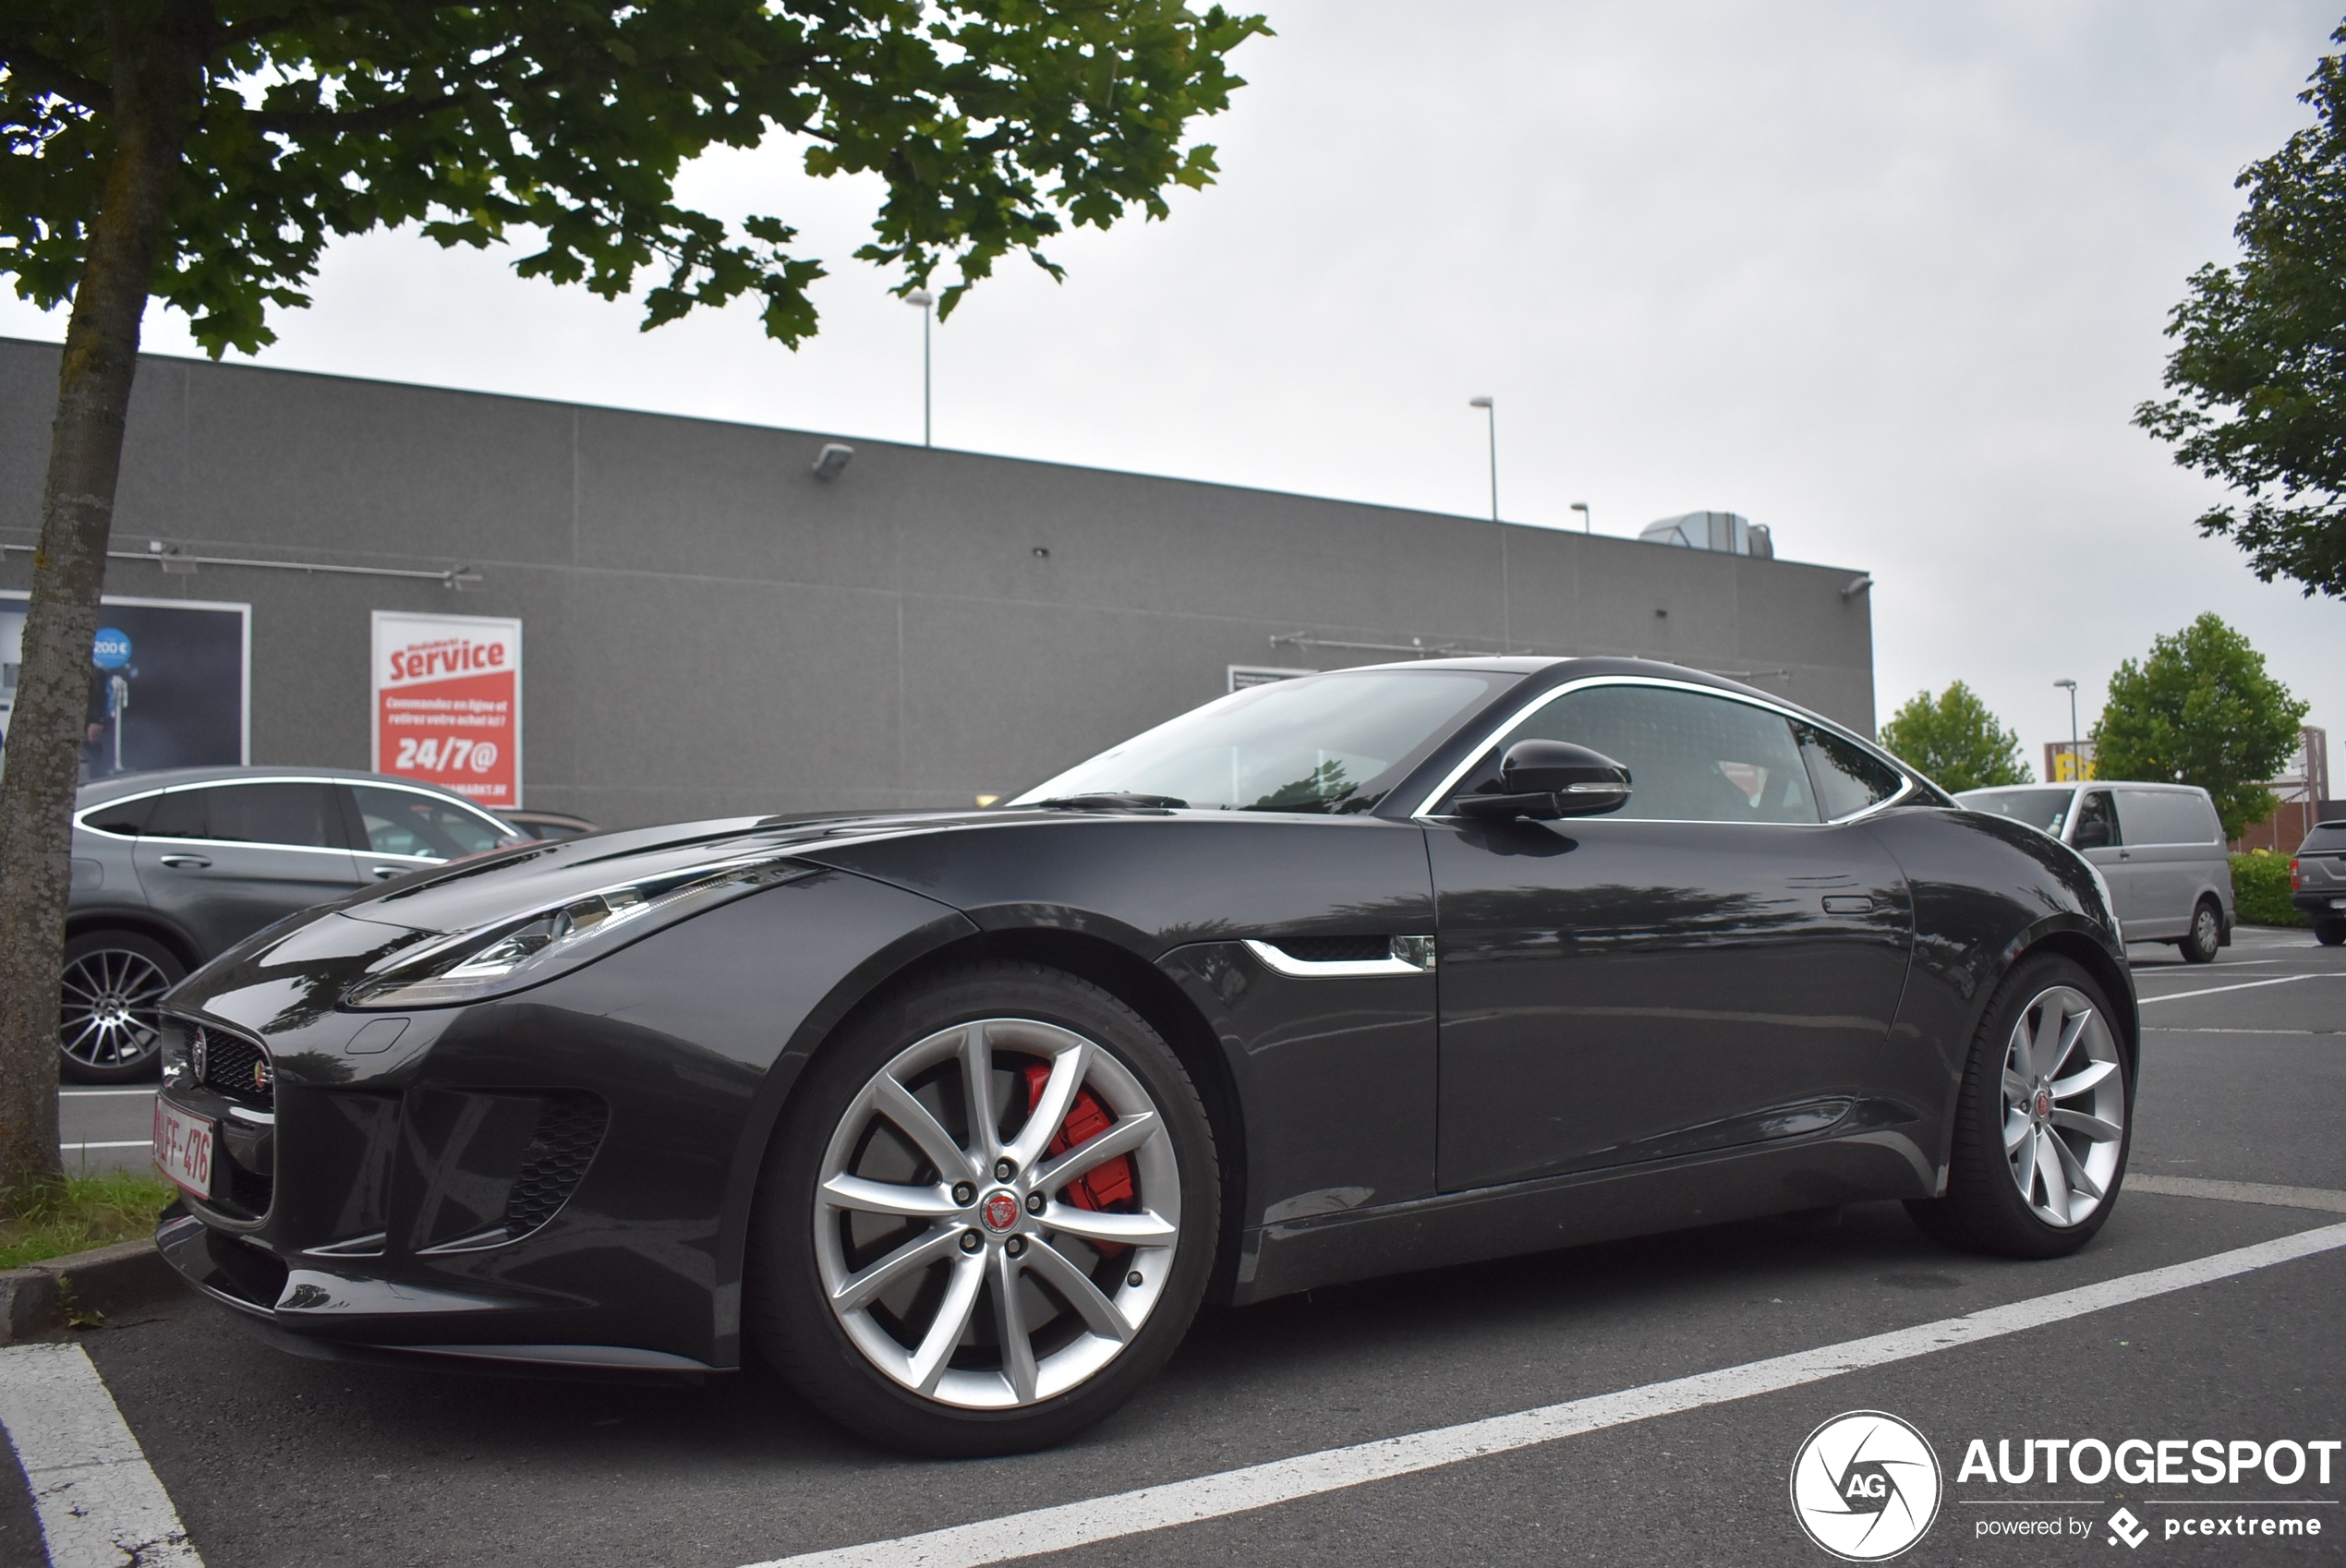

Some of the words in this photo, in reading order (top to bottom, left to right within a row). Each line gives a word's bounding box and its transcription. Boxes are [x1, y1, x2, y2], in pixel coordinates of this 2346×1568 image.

[391, 640, 504, 681] Service
[386, 696, 452, 710] Commandez
[453, 700, 467, 711] en
[468, 698, 494, 714] ligne
[496, 700, 507, 712] et
[389, 712, 425, 726] retirez
[427, 713, 455, 727] votre
[457, 714, 487, 728] achat
[395, 736, 498, 774] 24/7@
